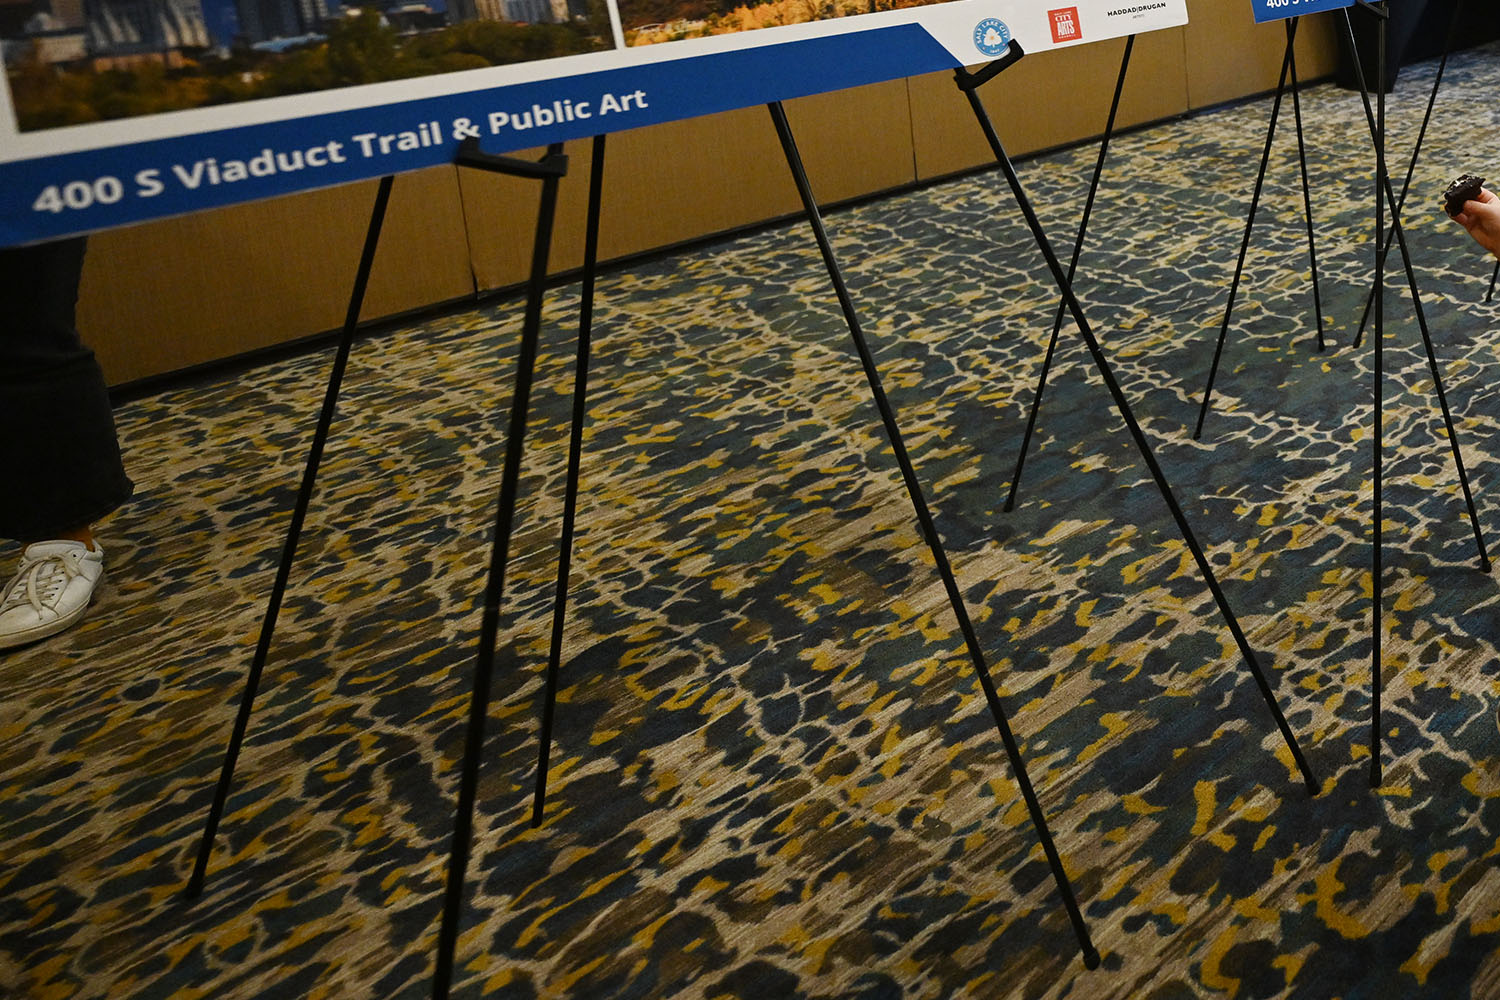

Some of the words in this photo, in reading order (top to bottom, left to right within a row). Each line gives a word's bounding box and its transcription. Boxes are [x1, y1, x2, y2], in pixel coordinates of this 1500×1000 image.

[1055, 14, 1071, 22] CITY
[1000, 25, 1009, 39] CITY
[1057, 20, 1075, 36] ARTS
[35, 177, 122, 212] 400
[136, 170, 163, 196] S
[173, 142, 346, 188] Viaduct
[352, 122, 442, 157] Trail
[453, 118, 480, 140] &
[488, 100, 591, 134] Public
[600, 90, 648, 115] Art
